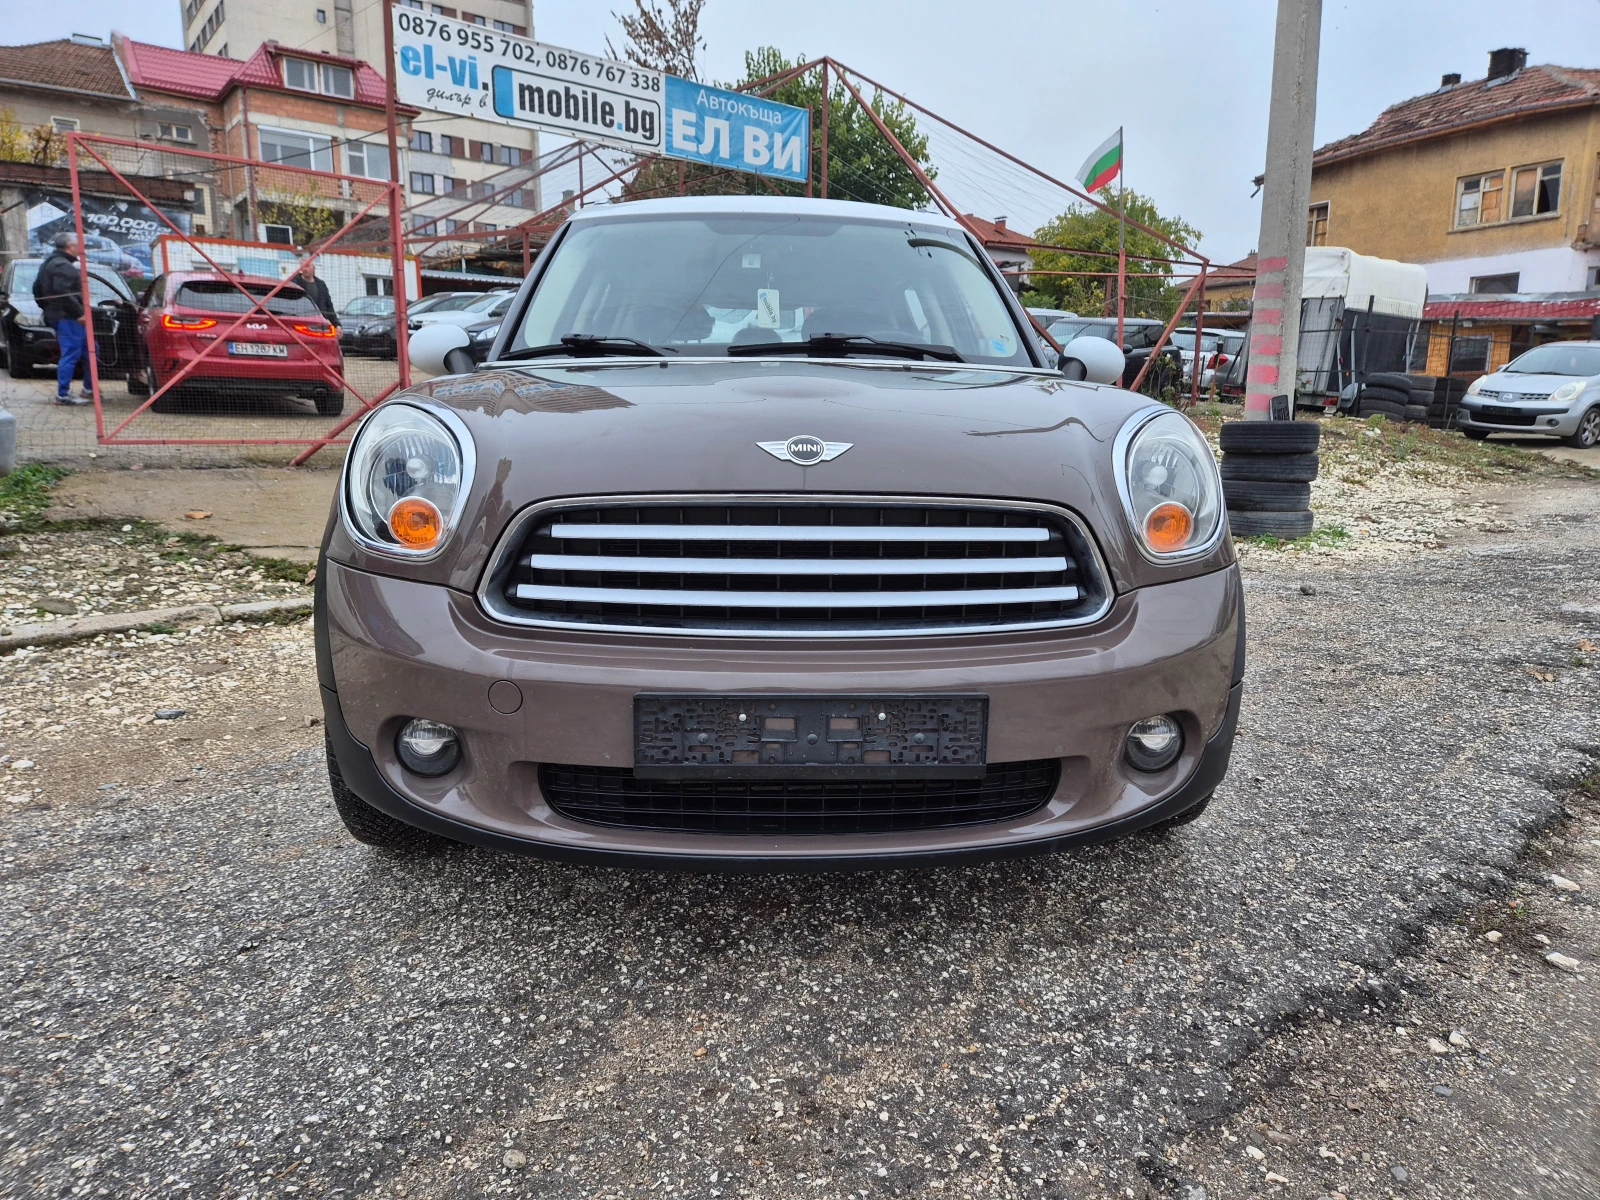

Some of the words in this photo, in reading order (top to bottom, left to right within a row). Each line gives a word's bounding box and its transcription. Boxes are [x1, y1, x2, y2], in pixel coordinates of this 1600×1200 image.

[398, 13, 452, 42] 0876
[457, 28, 494, 53] 955
[500, 39, 541, 67] 702,
[546, 51, 591, 76] 0876
[595, 62, 626, 84] 767
[631, 72, 661, 93] 338
[518, 82, 655, 141] mobile.bg
[697, 88, 782, 126] Автокъща
[672, 108, 730, 159] ЕЛ
[743, 125, 801, 173] ВИ
[87, 214, 119, 225] 100
[120, 218, 158, 230] 000
[790, 443, 821, 453] MINI
